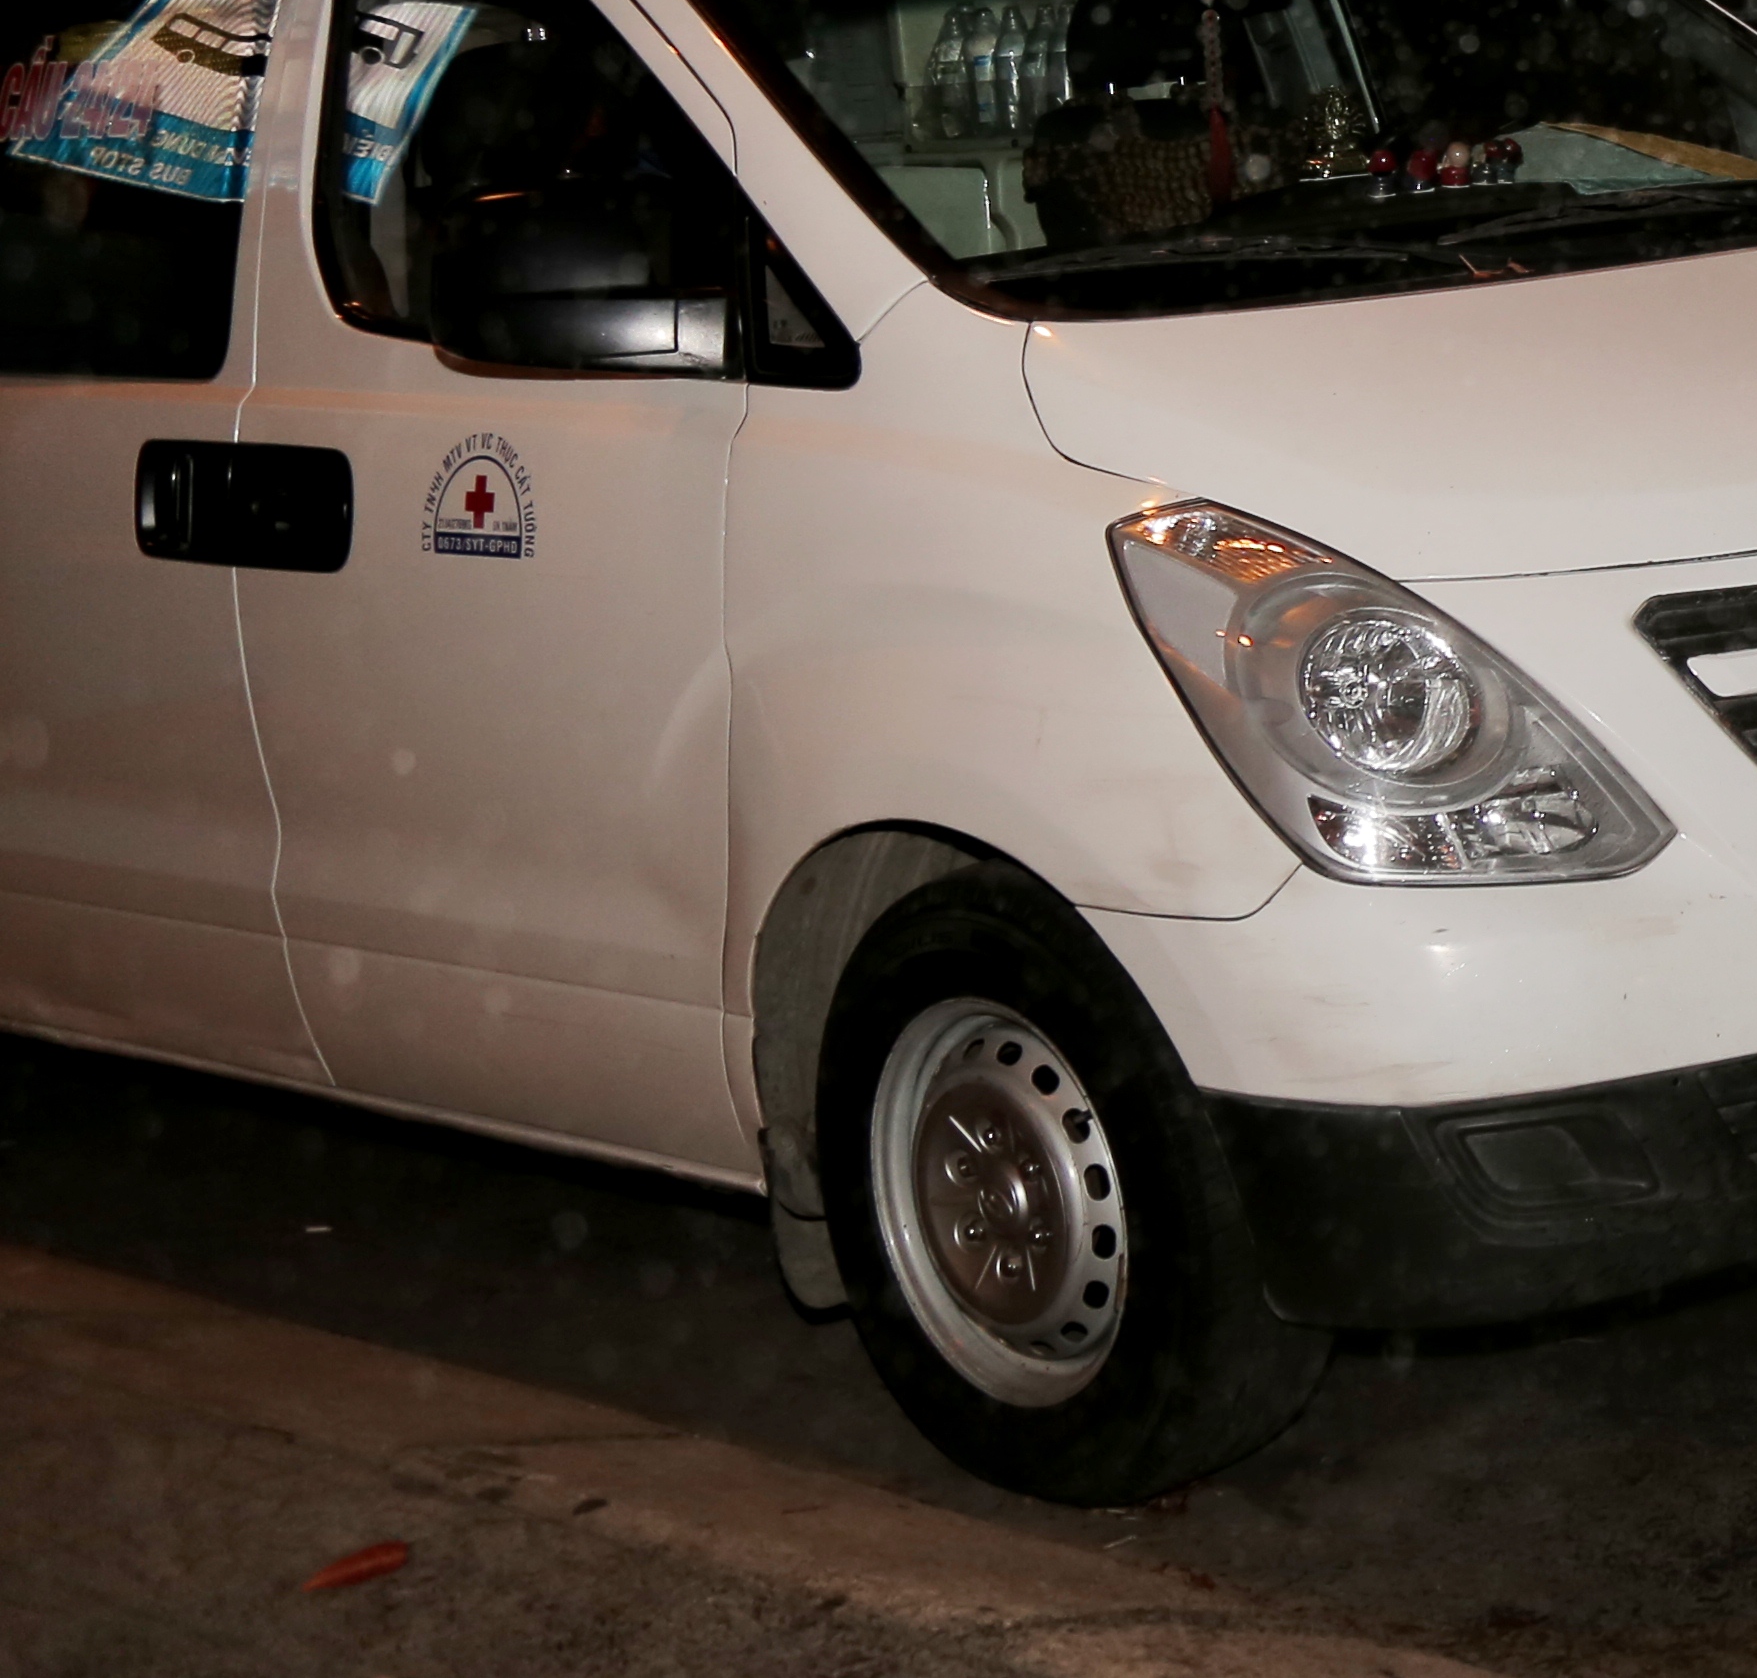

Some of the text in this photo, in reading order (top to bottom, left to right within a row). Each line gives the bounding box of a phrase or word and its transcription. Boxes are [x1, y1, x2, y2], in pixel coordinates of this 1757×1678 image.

[421, 521, 432, 553] CTY
[442, 442, 463, 473] MTV
[465, 433, 478, 453] VT
